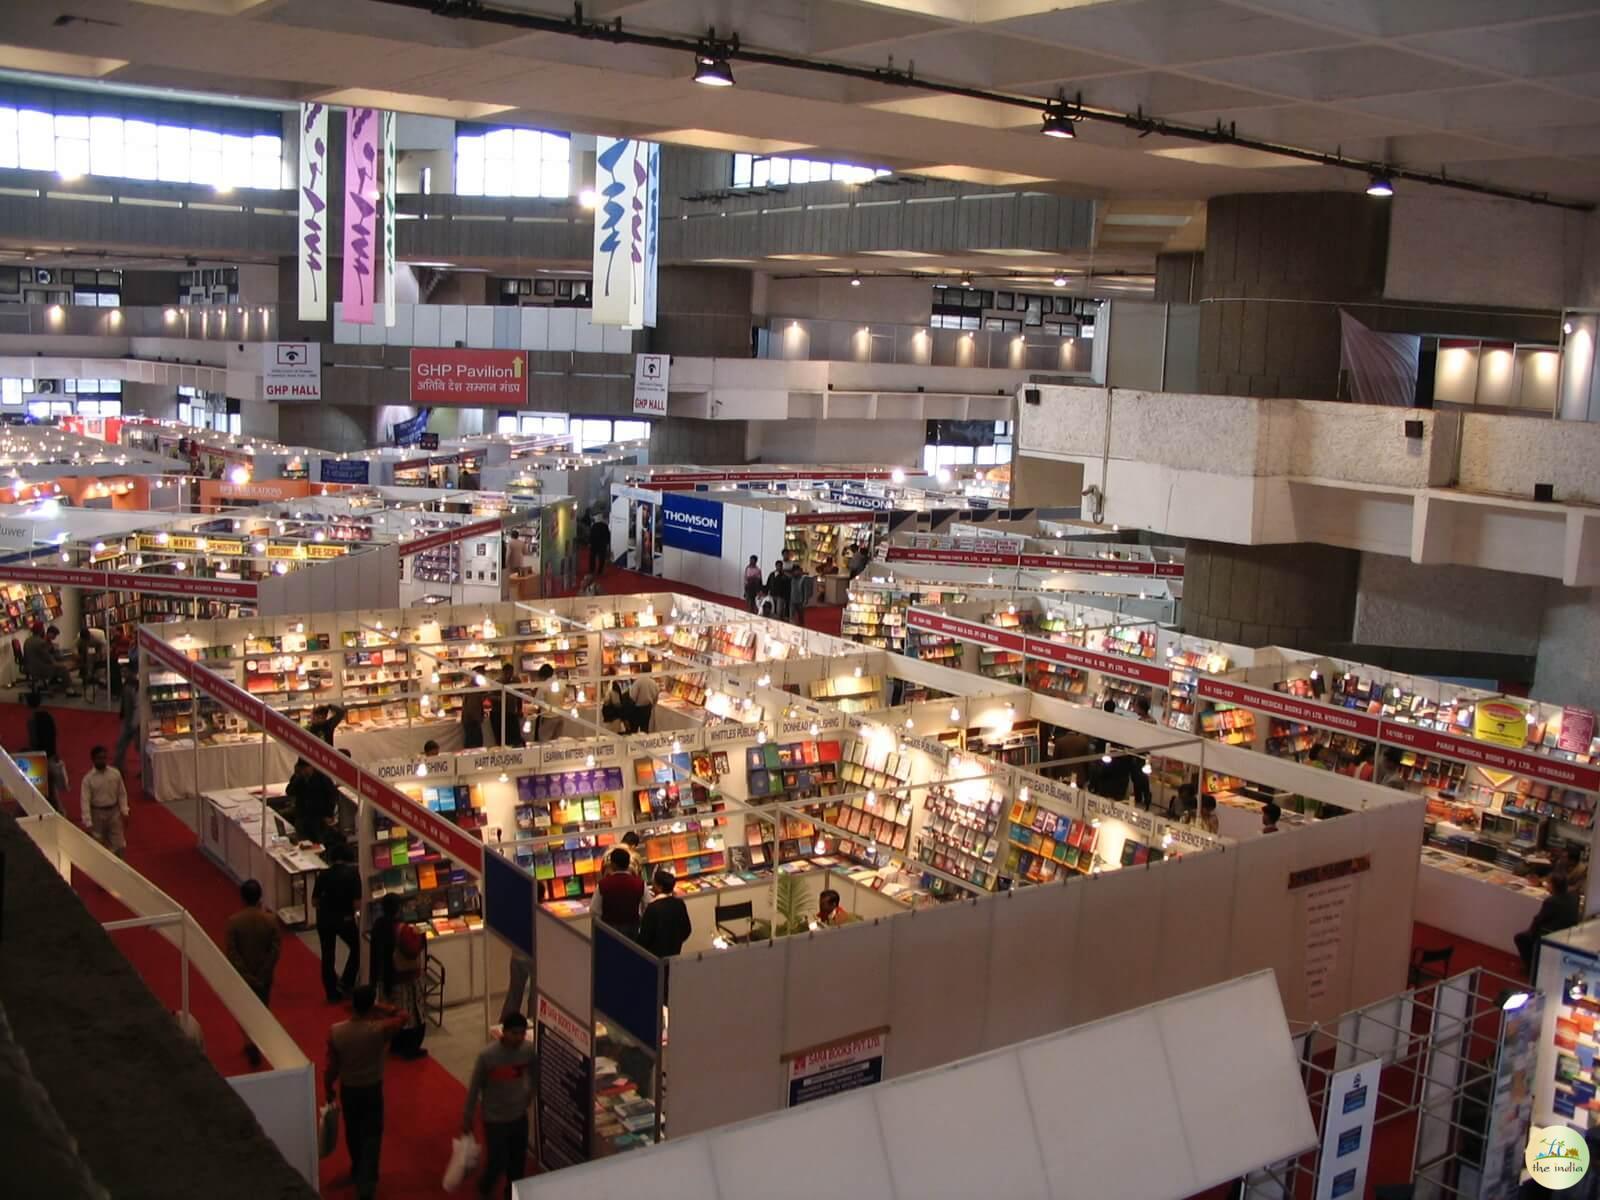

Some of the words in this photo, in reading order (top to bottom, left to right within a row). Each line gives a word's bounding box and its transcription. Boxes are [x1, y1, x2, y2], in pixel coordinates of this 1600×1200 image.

[417, 363, 452, 377] GHP
[456, 364, 513, 378] Pavilion
[266, 384, 289, 396] GHP
[291, 384, 319, 396] HALL
[417, 378, 445, 391] अतिथि
[448, 379, 462, 392] देश
[466, 382, 496, 393] सम्मान
[499, 380, 520, 393] मंडप
[635, 399, 648, 409] GHP
[649, 400, 665, 411] HALL
[663, 509, 718, 529] THOMSON
[1261, 698, 1283, 710] MEDICAL
[1284, 703, 1303, 714] BOOKS
[1324, 713, 1357, 728] HYDERABAD
[711, 728, 736, 740] WHITTLES
[1457, 745, 1483, 759] MEDICAL
[1485, 752, 1505, 765] BOOKS
[1507, 757, 1517, 768] (P)
[1537, 765, 1575, 780] HYDERABAD
[378, 766, 405, 778] JORDAN
